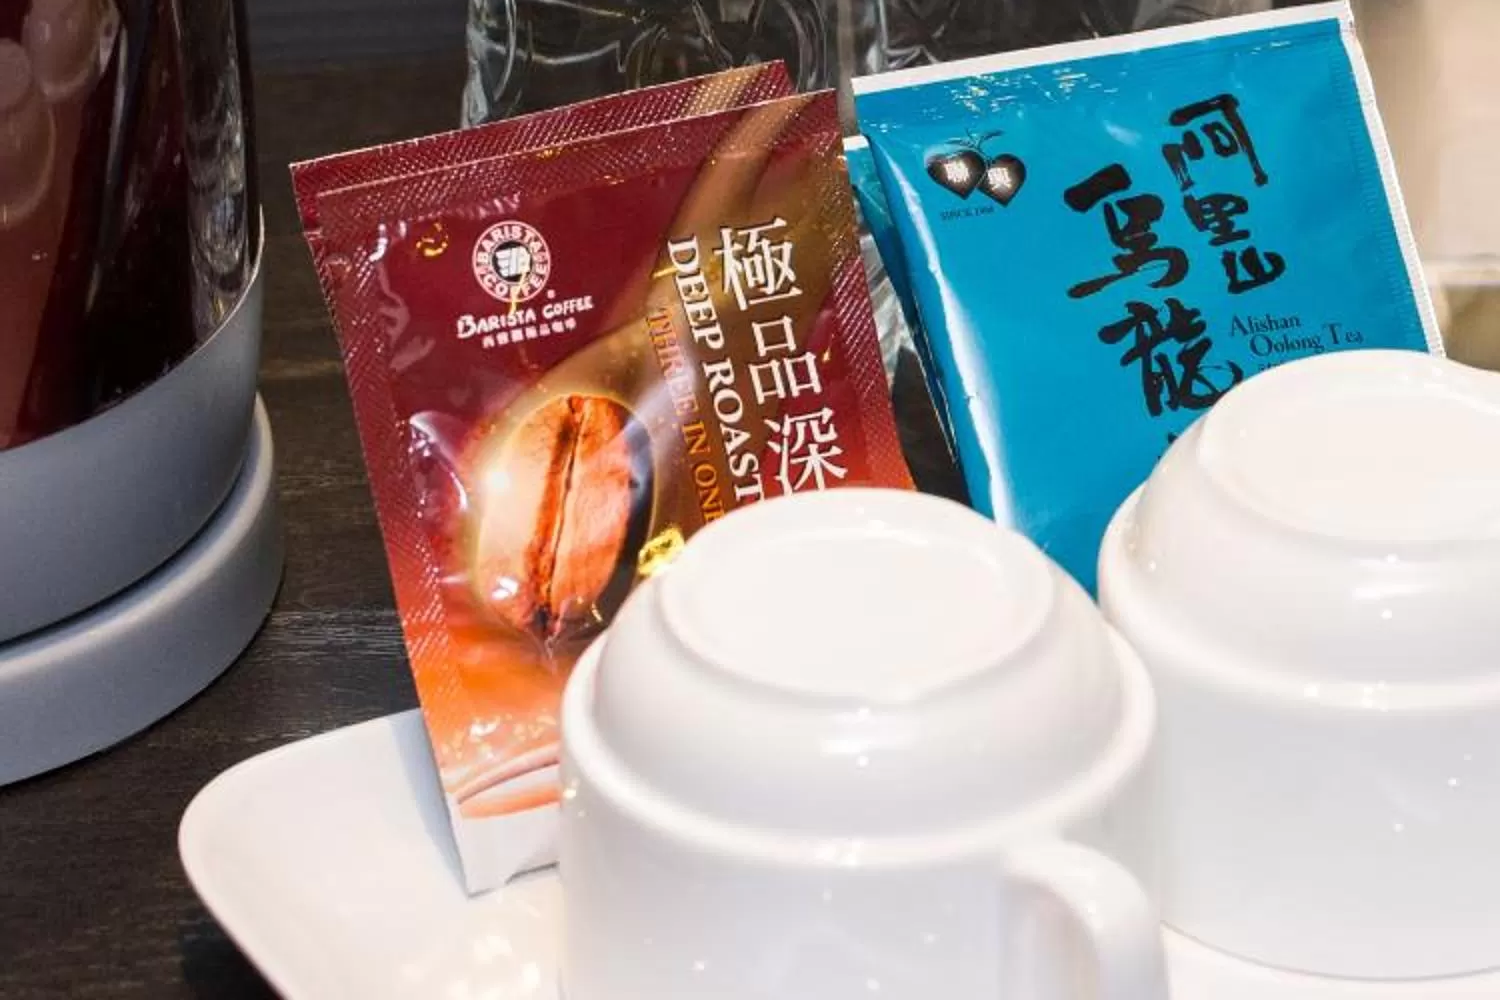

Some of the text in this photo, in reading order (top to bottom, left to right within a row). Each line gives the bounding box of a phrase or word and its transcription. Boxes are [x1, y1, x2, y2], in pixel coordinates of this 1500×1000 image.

[477, 225, 543, 264] BARISTA
[457, 308, 537, 339] BARISTA
[543, 296, 594, 320] COFFEE
[1063, 163, 1244, 445] 烏龍
[1230, 313, 1301, 338] Alishan
[1250, 322, 1364, 358] Oolong Tea
[646, 304, 700, 417] THREE
[681, 420, 711, 455] IN
[667, 232, 765, 502] DEEP ROAST
